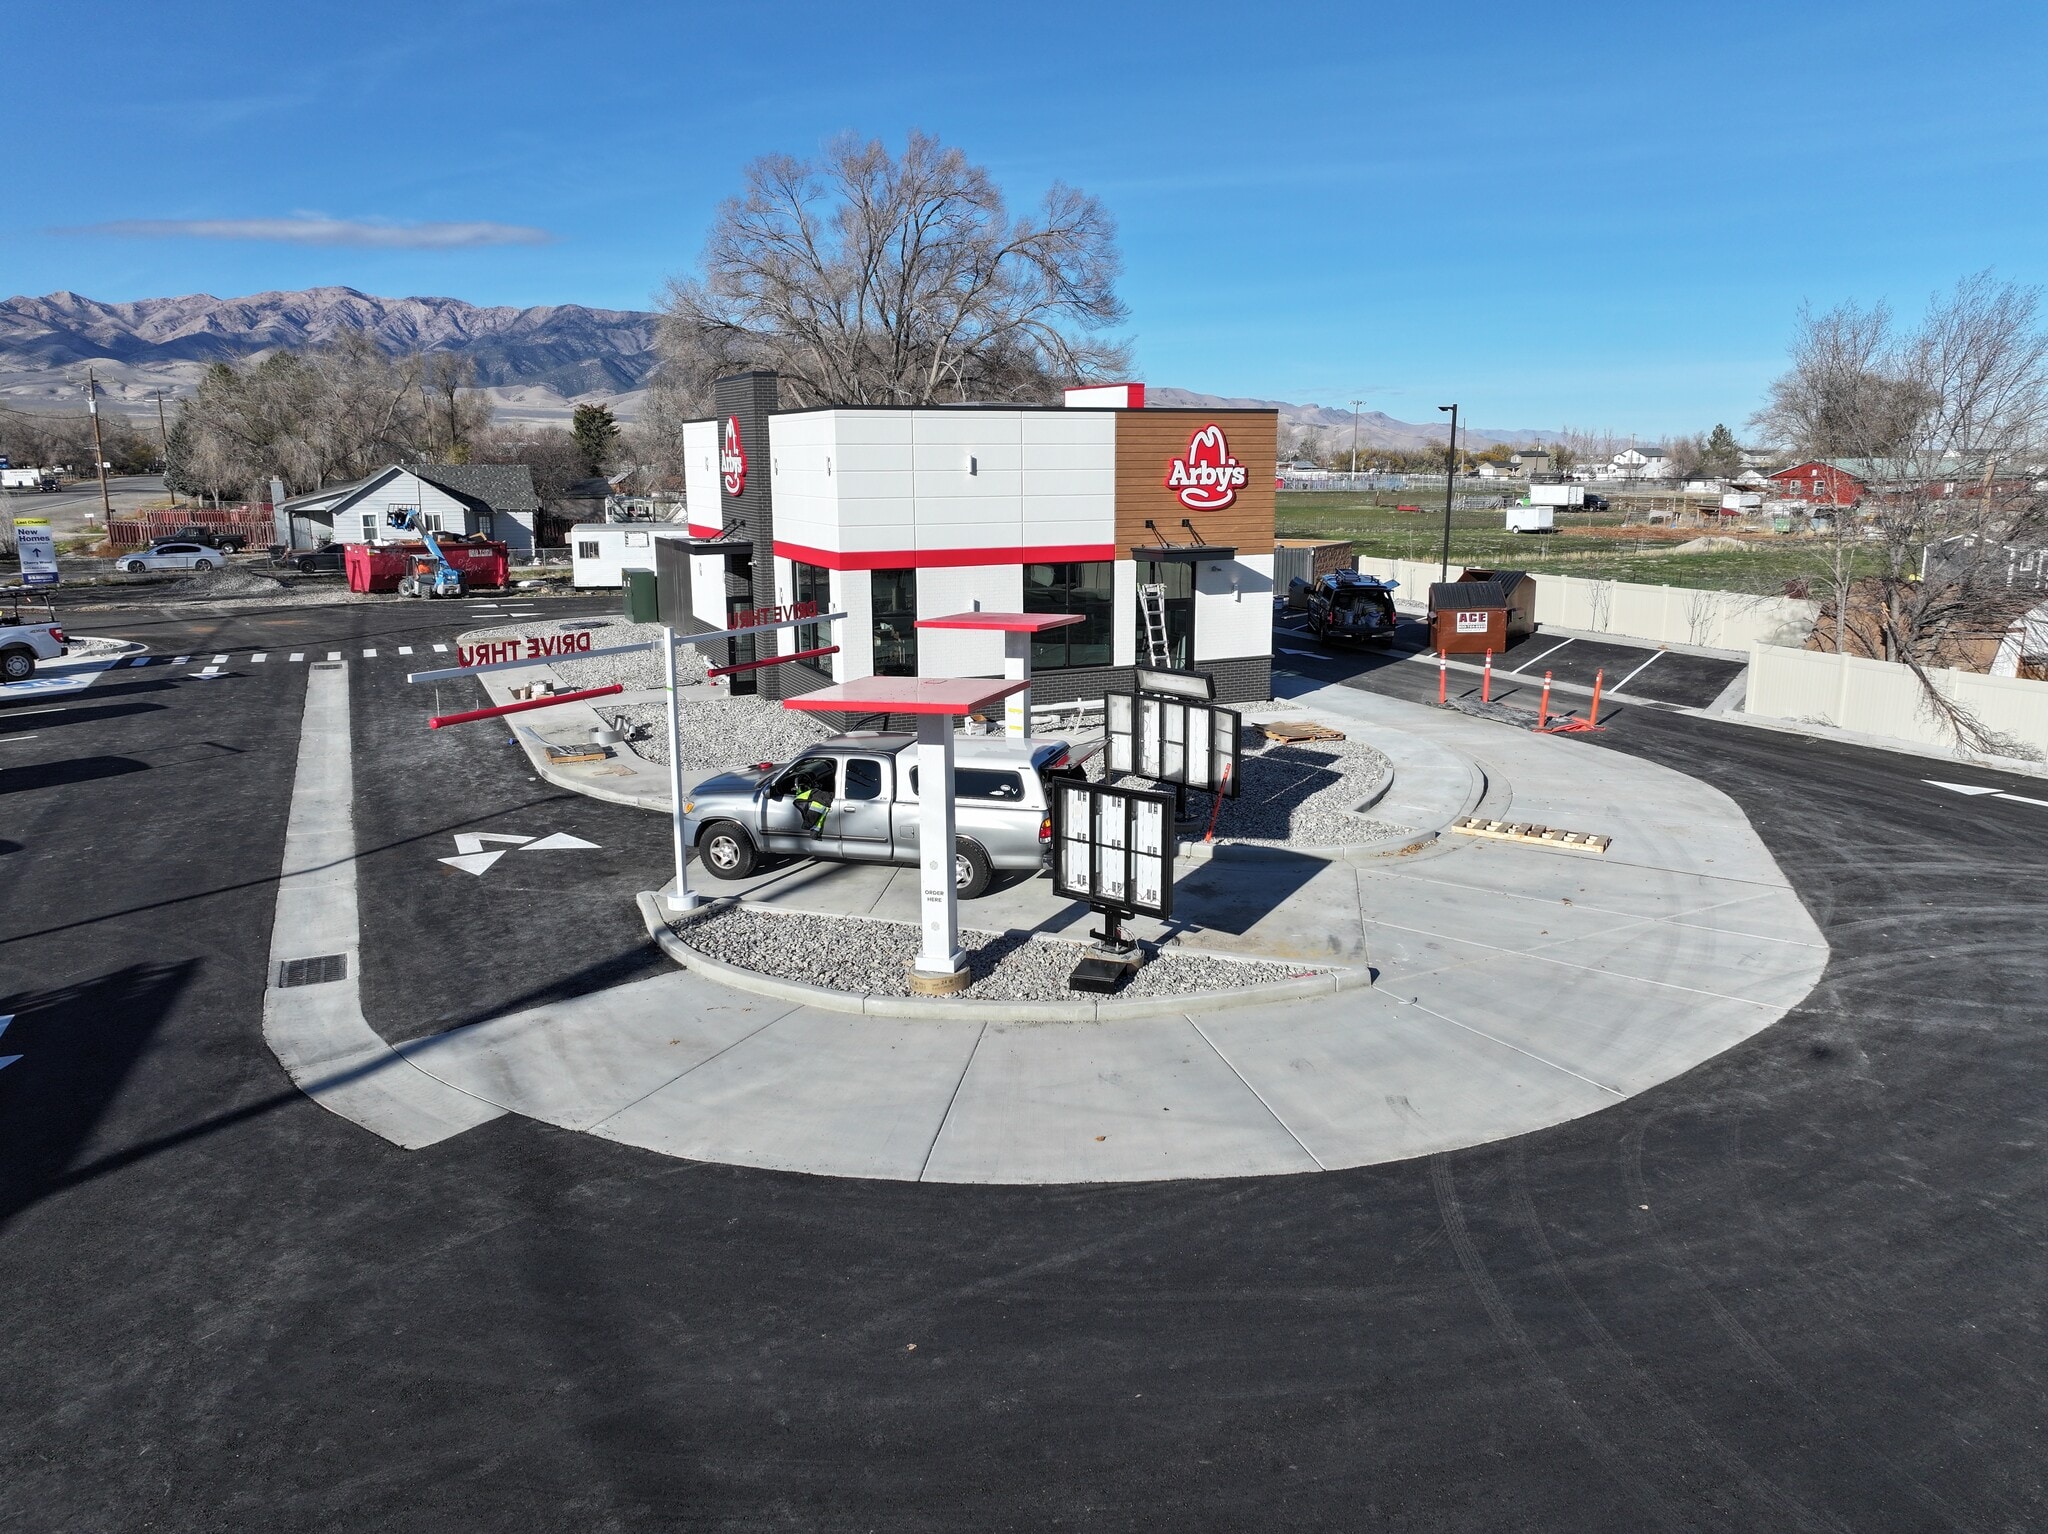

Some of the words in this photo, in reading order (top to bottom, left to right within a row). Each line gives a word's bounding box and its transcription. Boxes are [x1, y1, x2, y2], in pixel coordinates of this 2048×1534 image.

[721, 449, 742, 479] Arby's
[1169, 458, 1245, 492] Arby's
[1459, 613, 1486, 622] ACE
